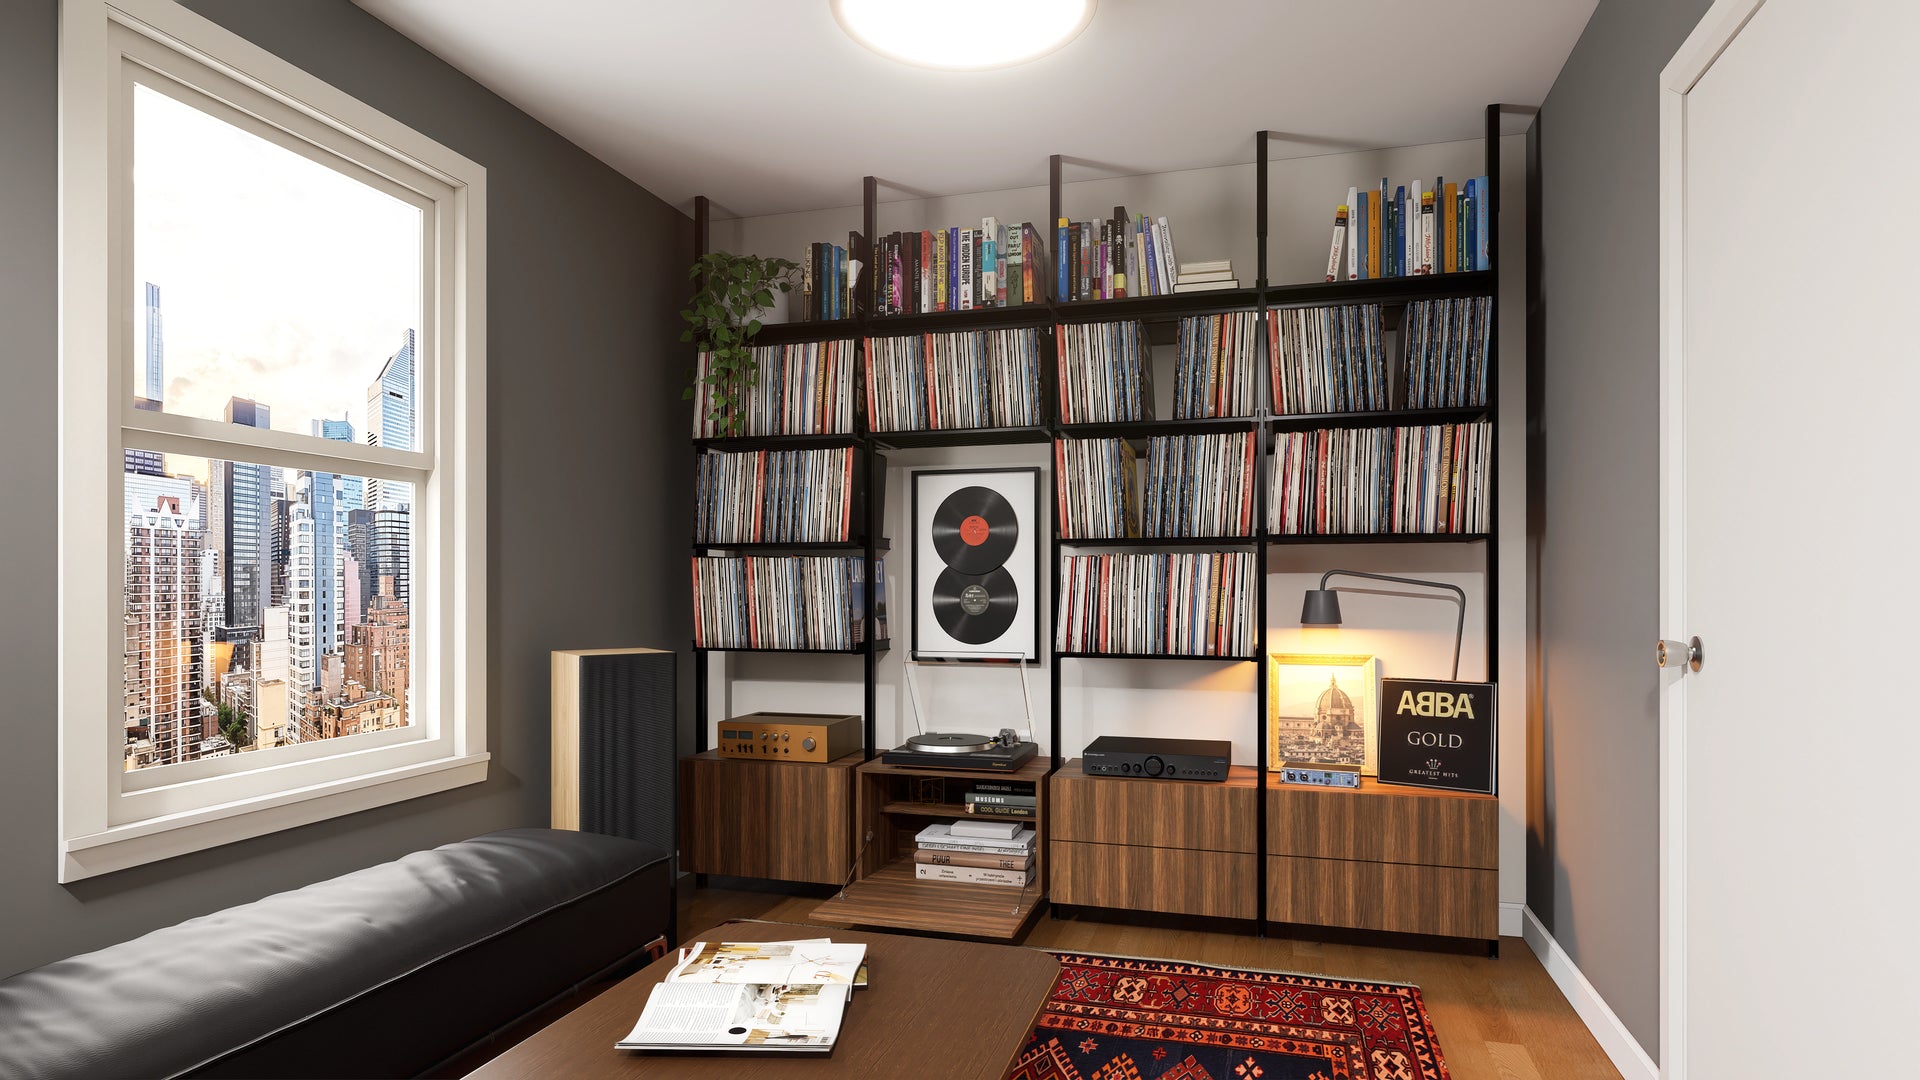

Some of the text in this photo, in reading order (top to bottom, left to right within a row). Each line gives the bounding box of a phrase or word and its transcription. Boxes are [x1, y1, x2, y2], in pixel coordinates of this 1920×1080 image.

[961, 231, 970, 243] THE
[961, 243, 970, 264] HIDDEN
[961, 264, 970, 286] EUROPE
[1396, 690, 1475, 719] ABBA
[1407, 731, 1462, 749] GOLD
[1408, 768, 1440, 777] GREATEST
[932, 854, 1014, 869] PUUR THEE
